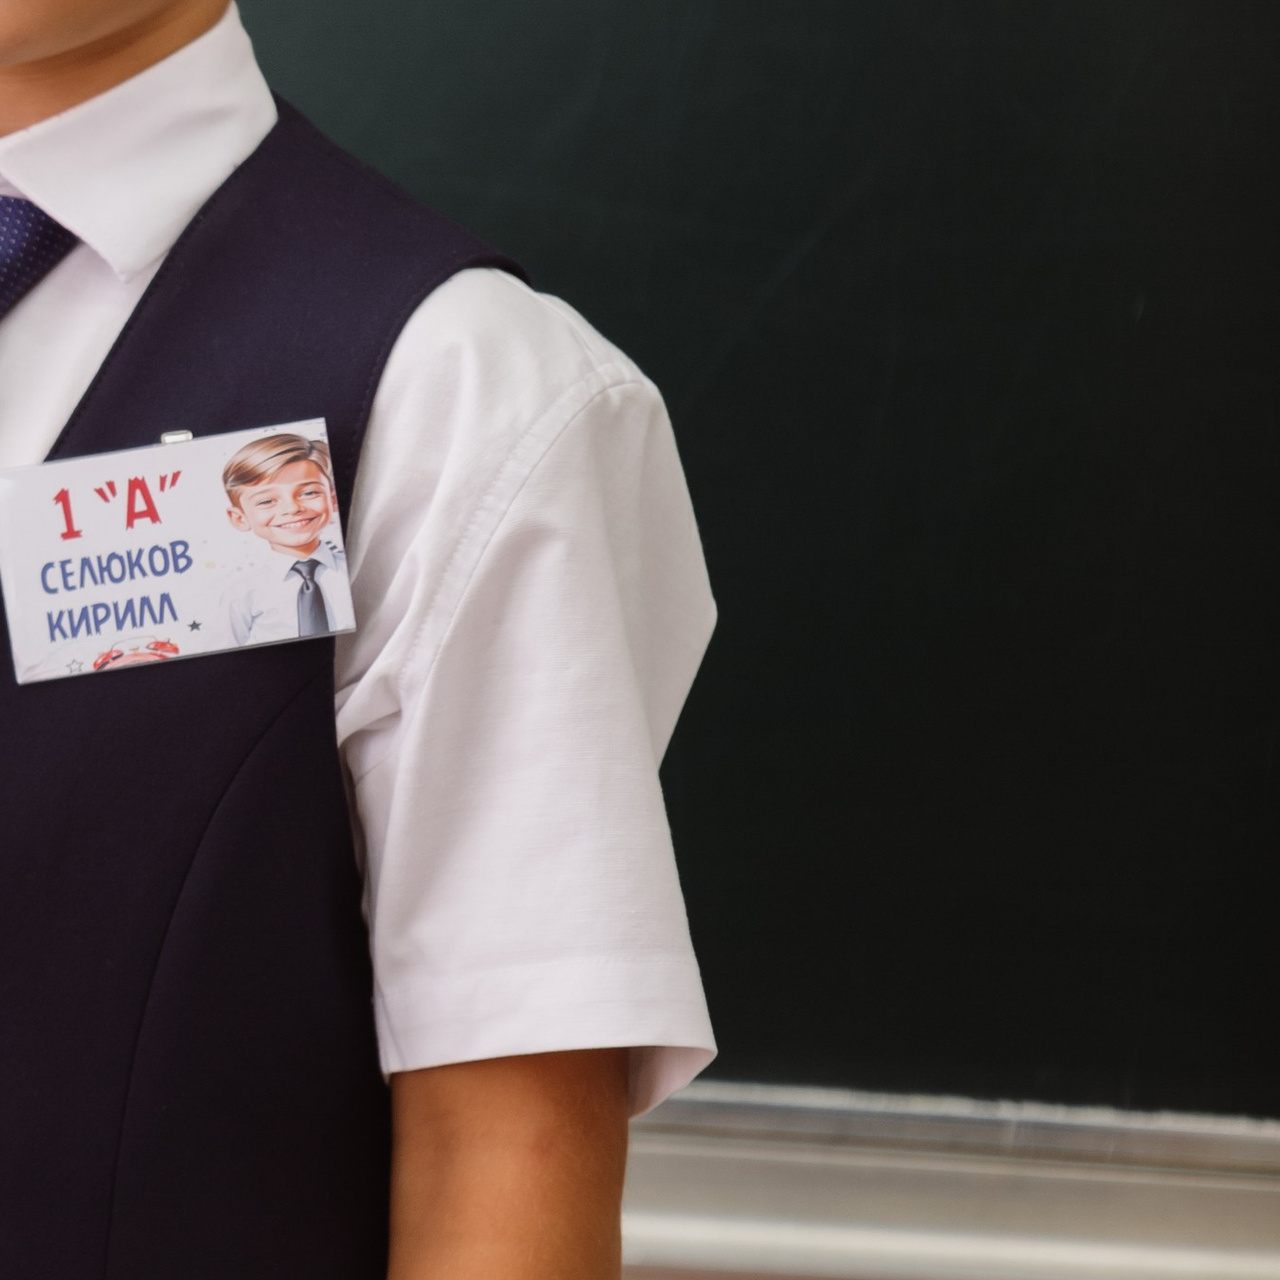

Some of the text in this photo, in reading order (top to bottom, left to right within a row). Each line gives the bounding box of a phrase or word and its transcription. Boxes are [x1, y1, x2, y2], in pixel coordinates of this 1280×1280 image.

[53, 488, 83, 541] 1
[40, 539, 193, 595] СЕЛЮКОВ
[46, 592, 179, 642] КИРИЛЛ
